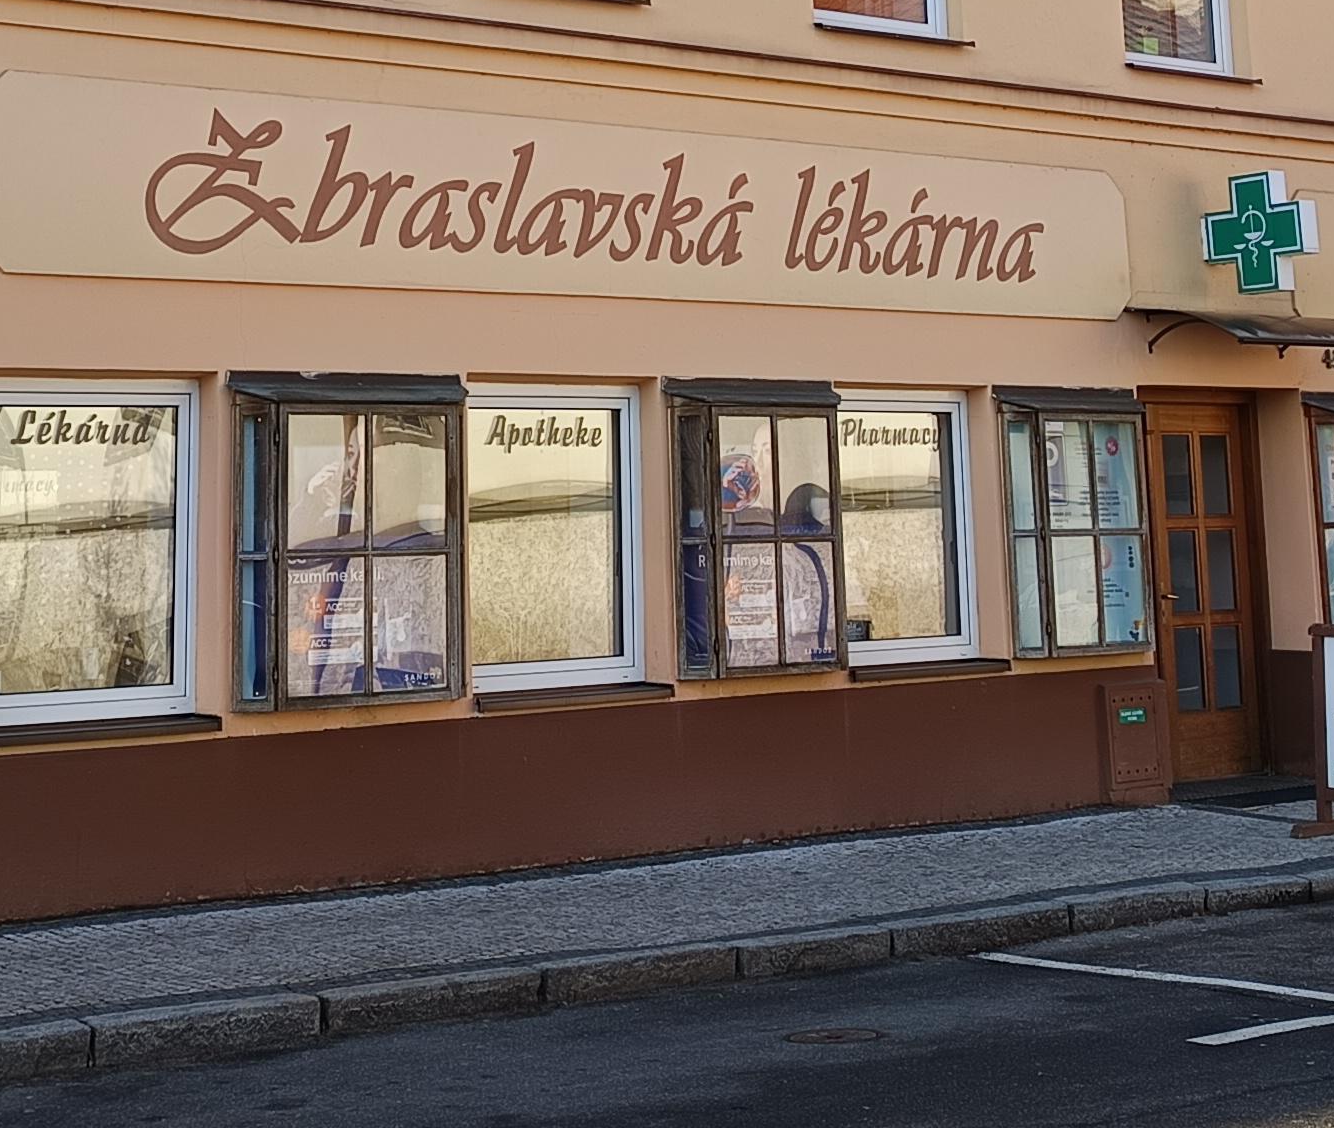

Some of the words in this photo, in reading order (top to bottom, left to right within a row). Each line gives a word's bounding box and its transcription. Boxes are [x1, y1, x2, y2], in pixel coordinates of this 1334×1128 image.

[145, 107, 754, 266] Zbraslavská
[784, 165, 1044, 283] lékárna
[10, 410, 151, 446] Lékárna
[485, 415, 603, 453] Apotheke
[840, 418, 940, 452] Pharmacy
